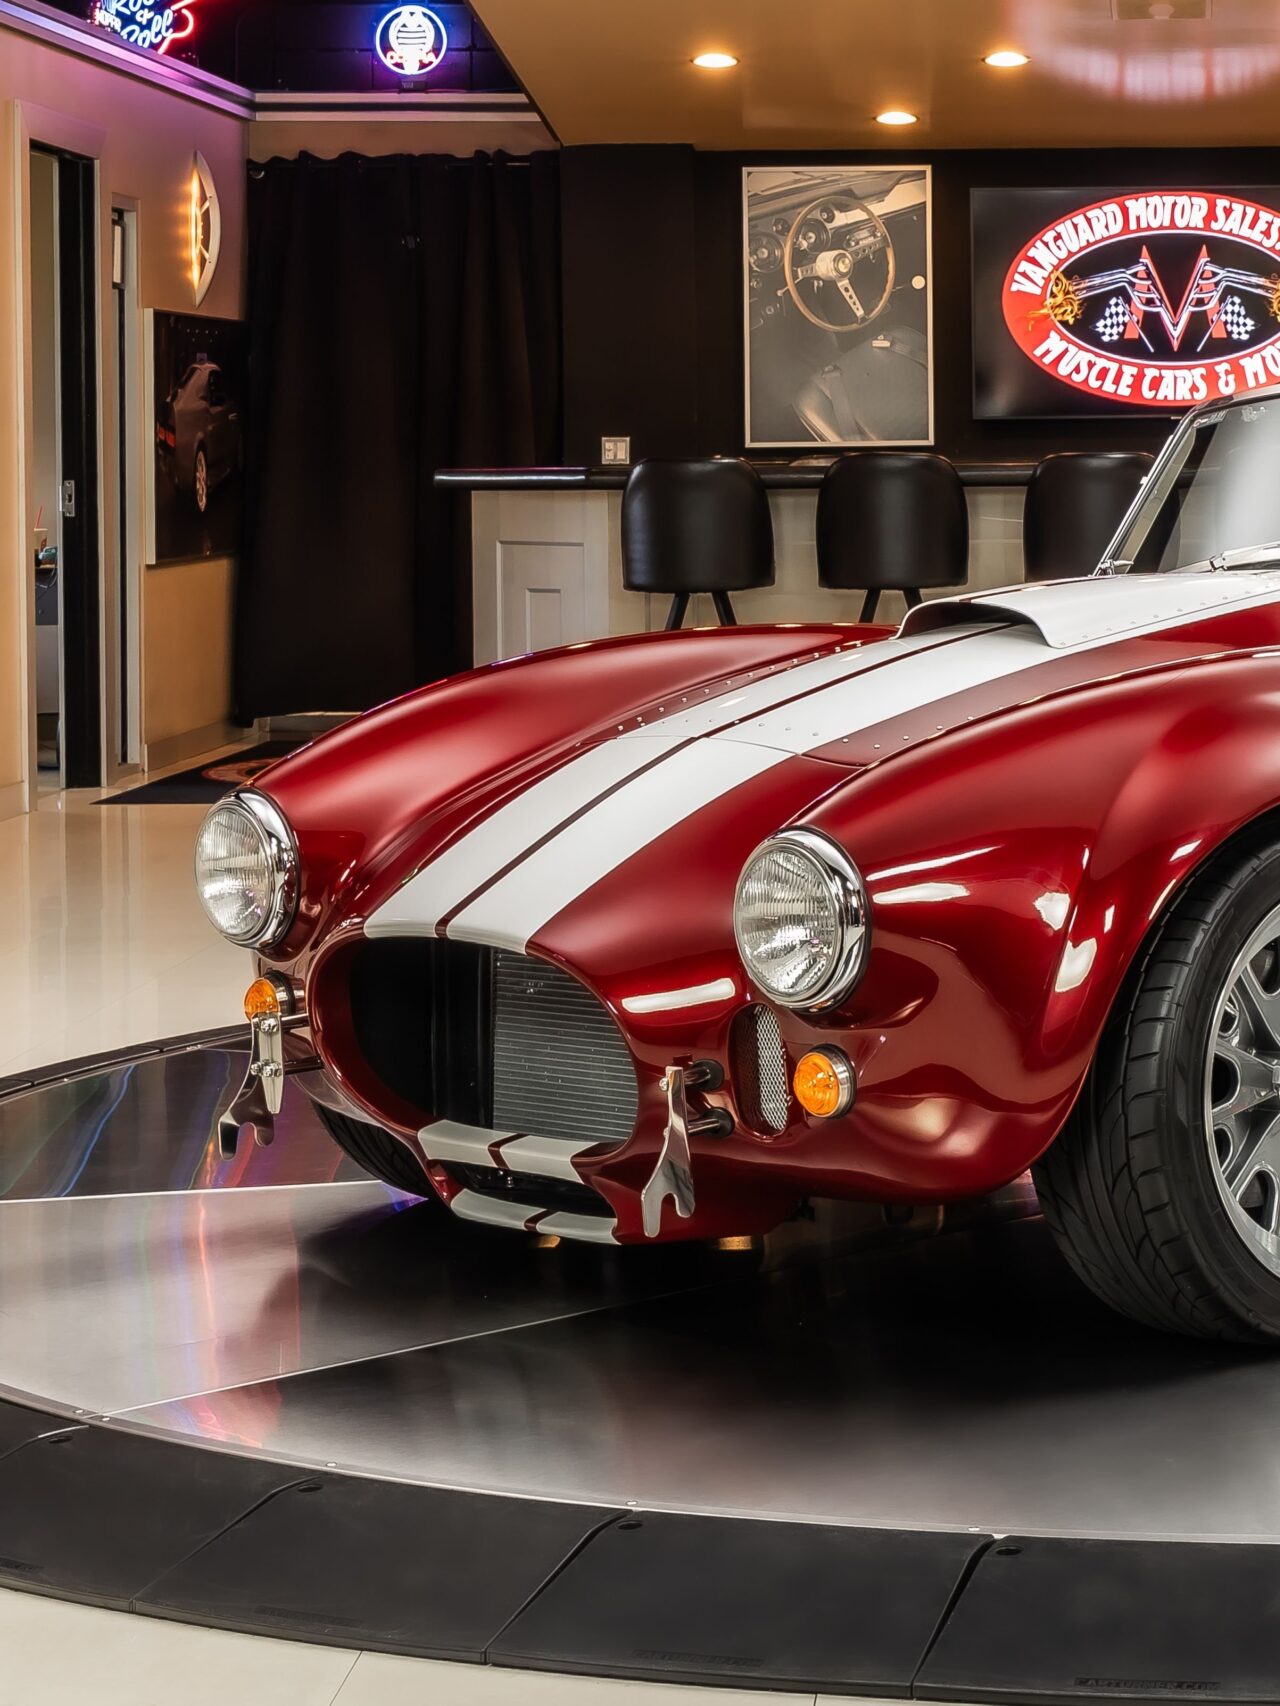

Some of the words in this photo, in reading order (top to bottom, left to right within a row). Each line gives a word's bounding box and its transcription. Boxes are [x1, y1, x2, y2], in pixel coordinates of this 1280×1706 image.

[1010, 203, 1124, 295] VANGUARD
[1124, 195, 1208, 230] MOTOR
[1032, 330, 1139, 397] MUSCLE
[1141, 366, 1208, 401] CARS
[1214, 363, 1236, 395] &
